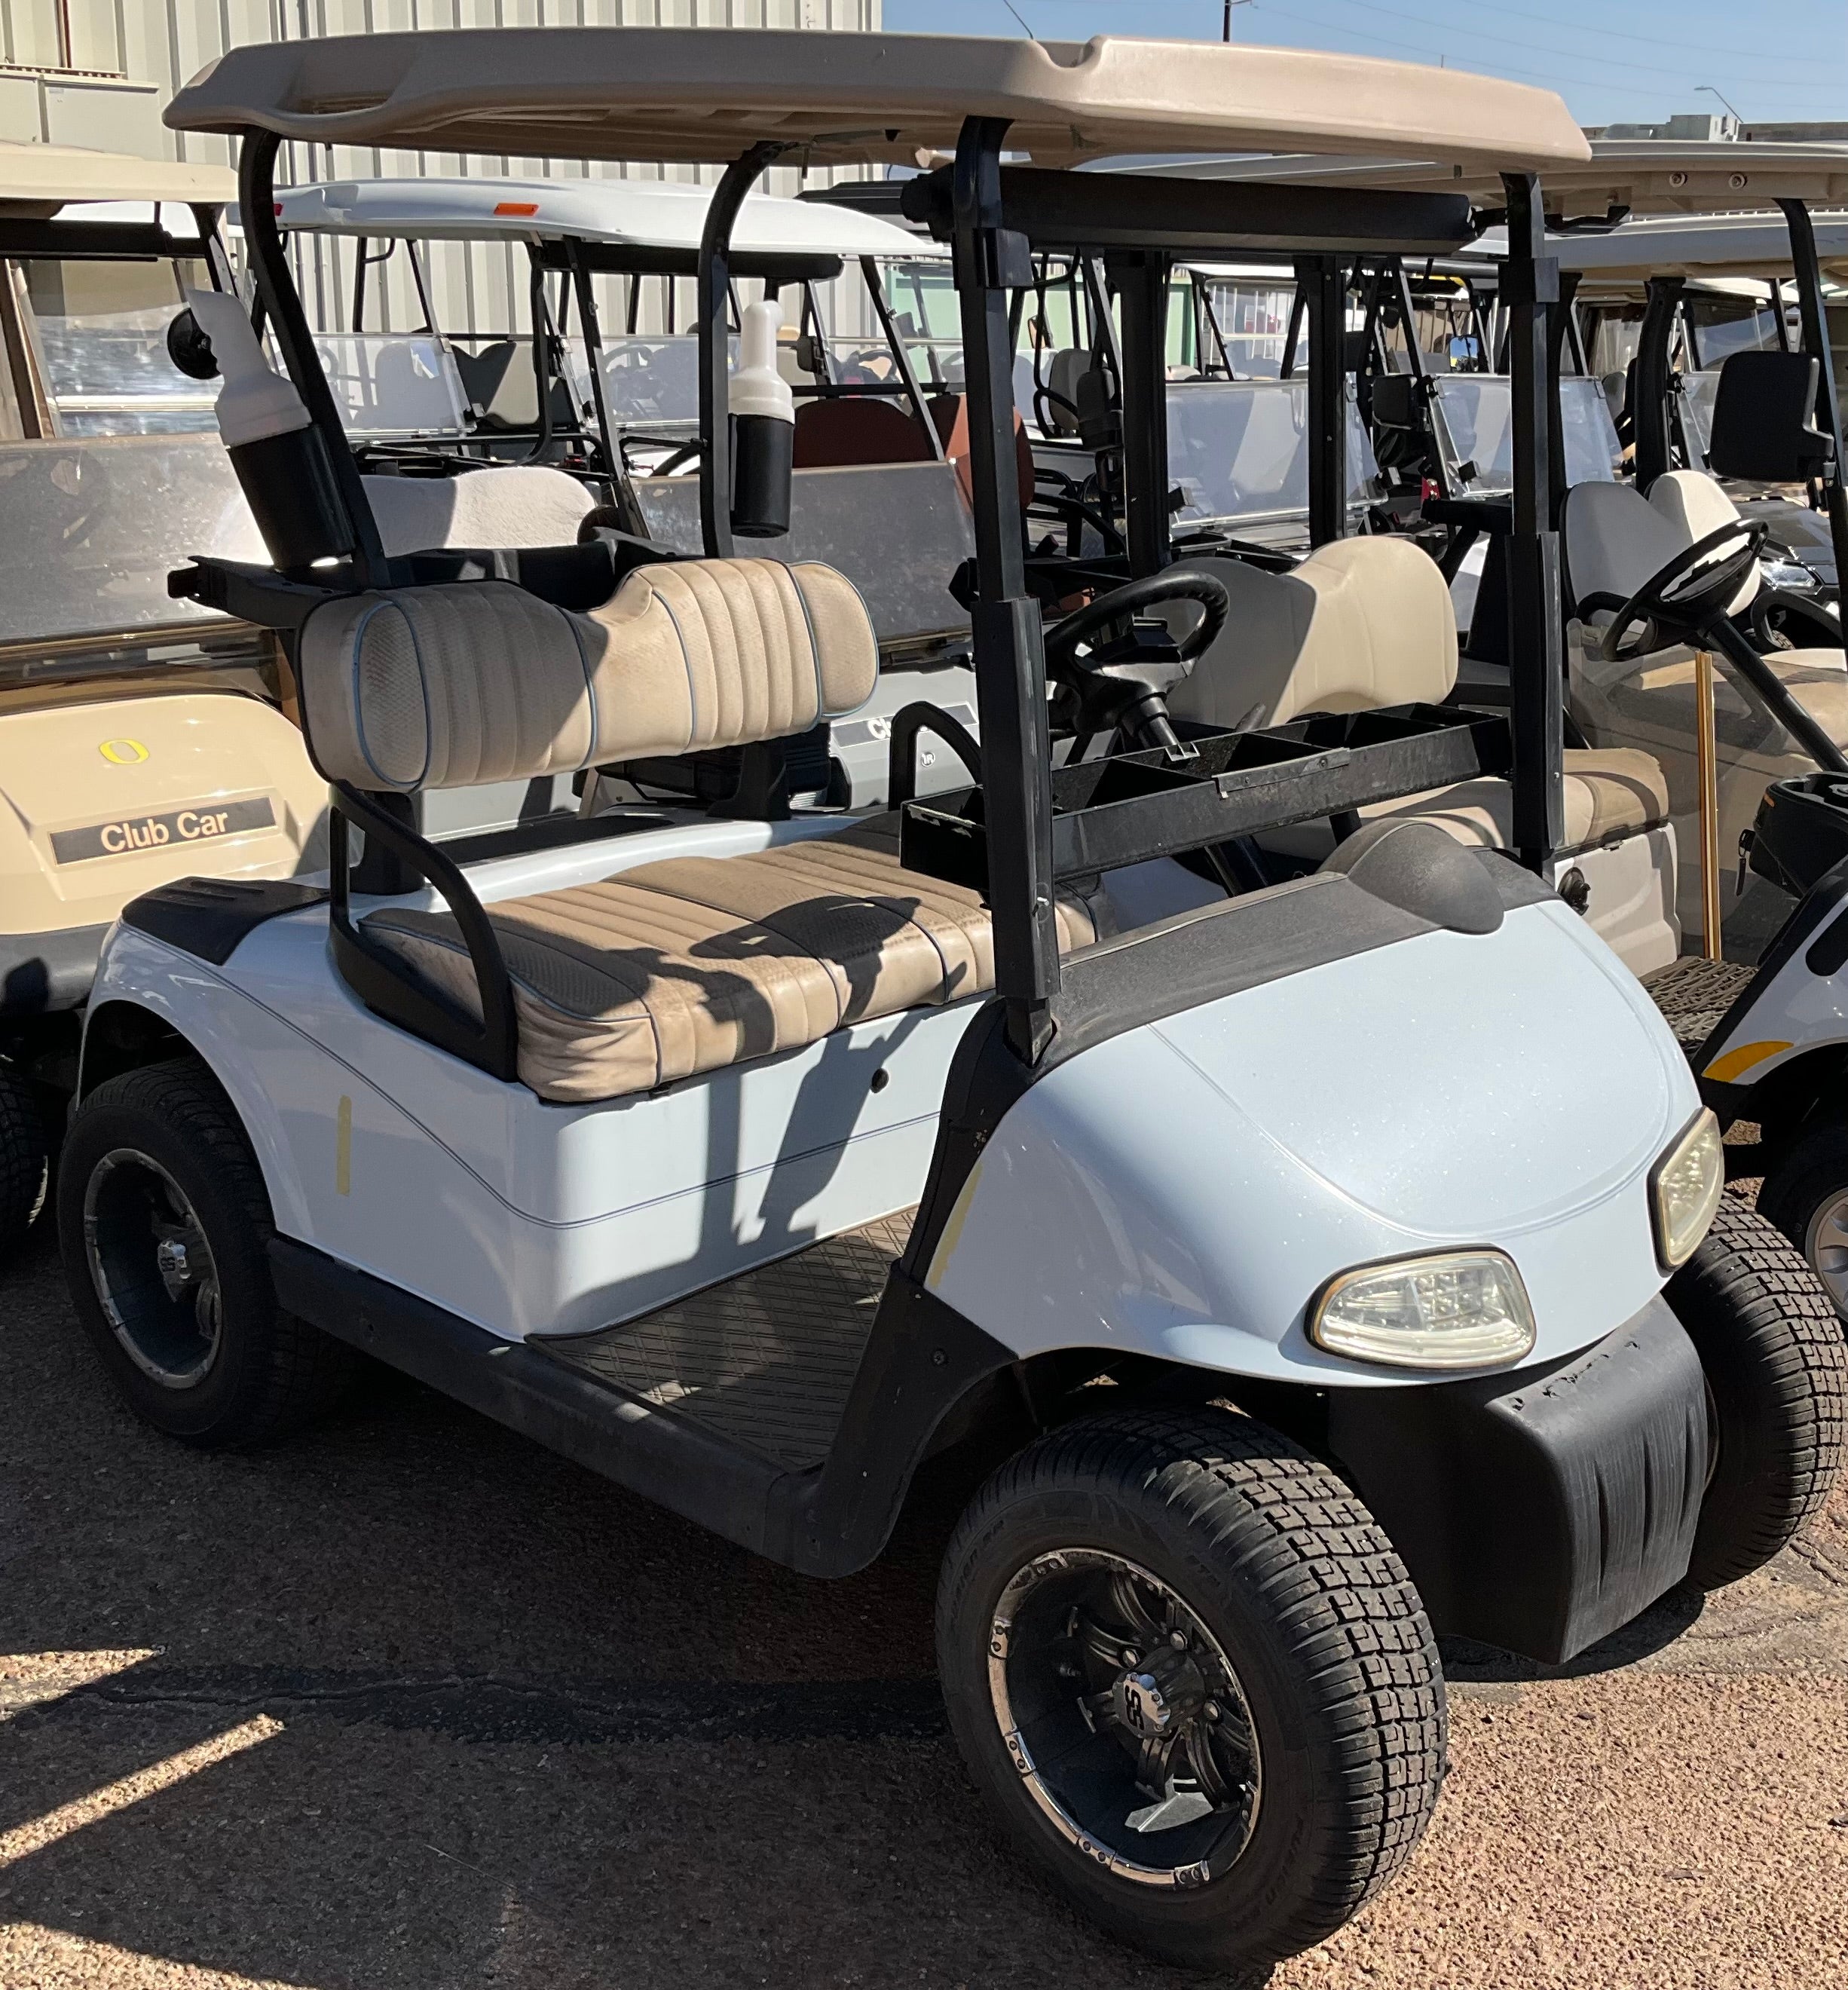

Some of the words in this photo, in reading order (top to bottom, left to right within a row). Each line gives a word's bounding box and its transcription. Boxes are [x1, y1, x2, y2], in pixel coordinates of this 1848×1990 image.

[867, 718, 892, 739] Cl
[100, 819, 170, 853] Club
[177, 811, 228, 838] Car
